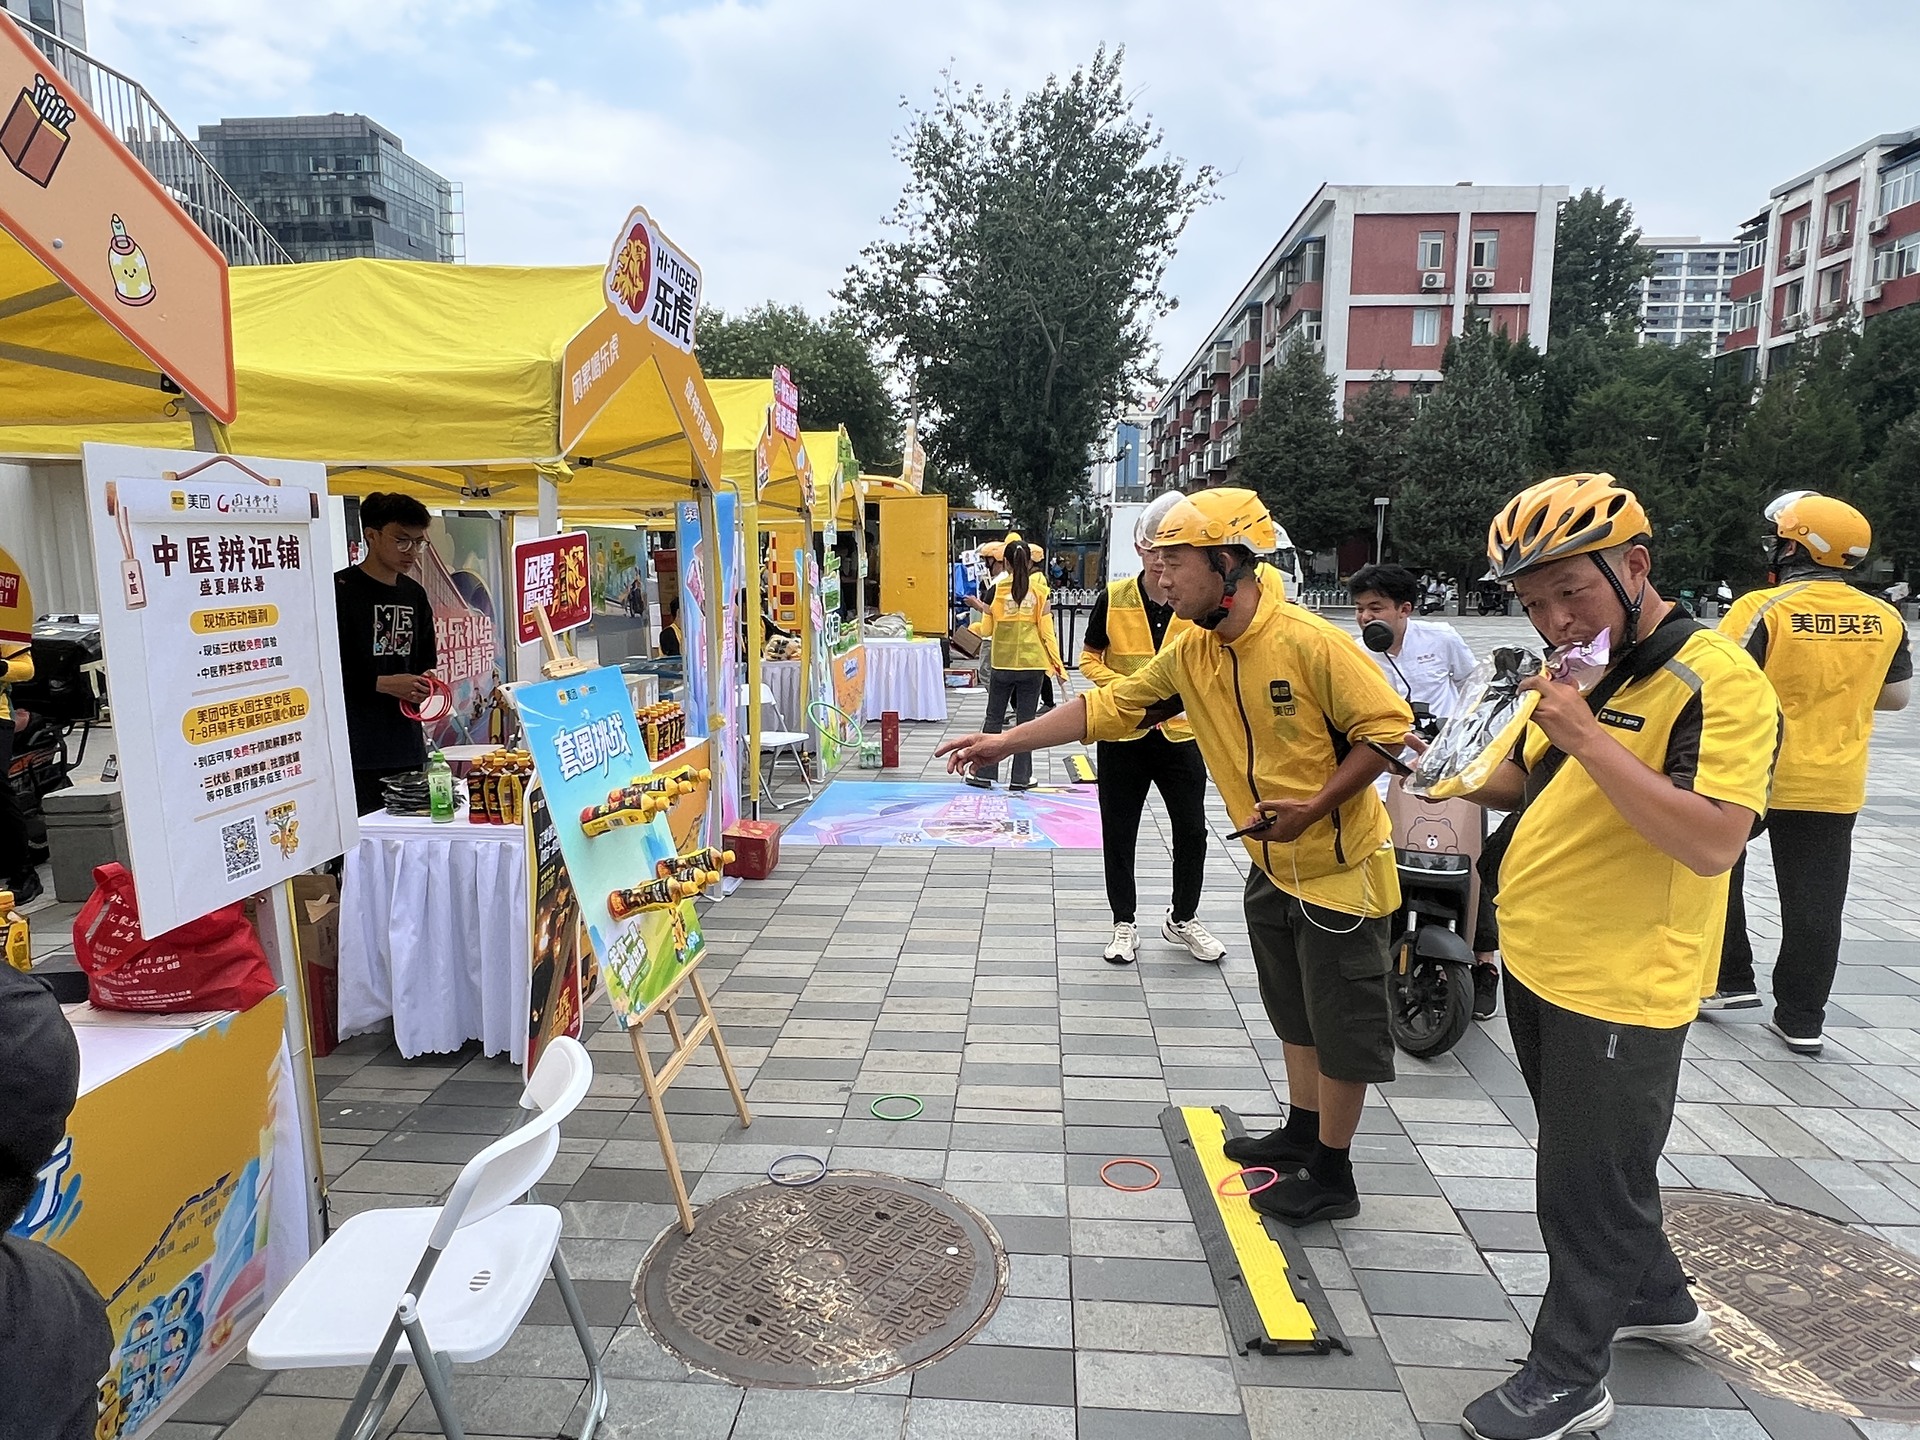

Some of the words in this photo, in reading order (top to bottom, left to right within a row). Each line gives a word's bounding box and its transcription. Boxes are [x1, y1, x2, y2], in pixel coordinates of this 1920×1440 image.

[656, 245, 698, 298] HI-TIGER
[651, 276, 693, 345] 乐虎
[188, 494, 211, 509] 美团
[152, 534, 301, 576] 中医辨证铺
[524, 552, 555, 591] 困累
[127, 570, 139, 595] 中医
[200, 575, 266, 597] 盛夏解伏暑
[203, 608, 268, 629] 现场活动福利
[432, 616, 493, 651] 快乐补给
[1790, 613, 1883, 635] 美团买药
[203, 636, 277, 656] 现场三伏贴免费体验
[436, 643, 495, 684] 奇遇清凉
[189, 704, 306, 741] 7-8月骑手专属到店暖心权益
[1272, 705, 1296, 717] 美团
[554, 713, 633, 782] 套圈挑战
